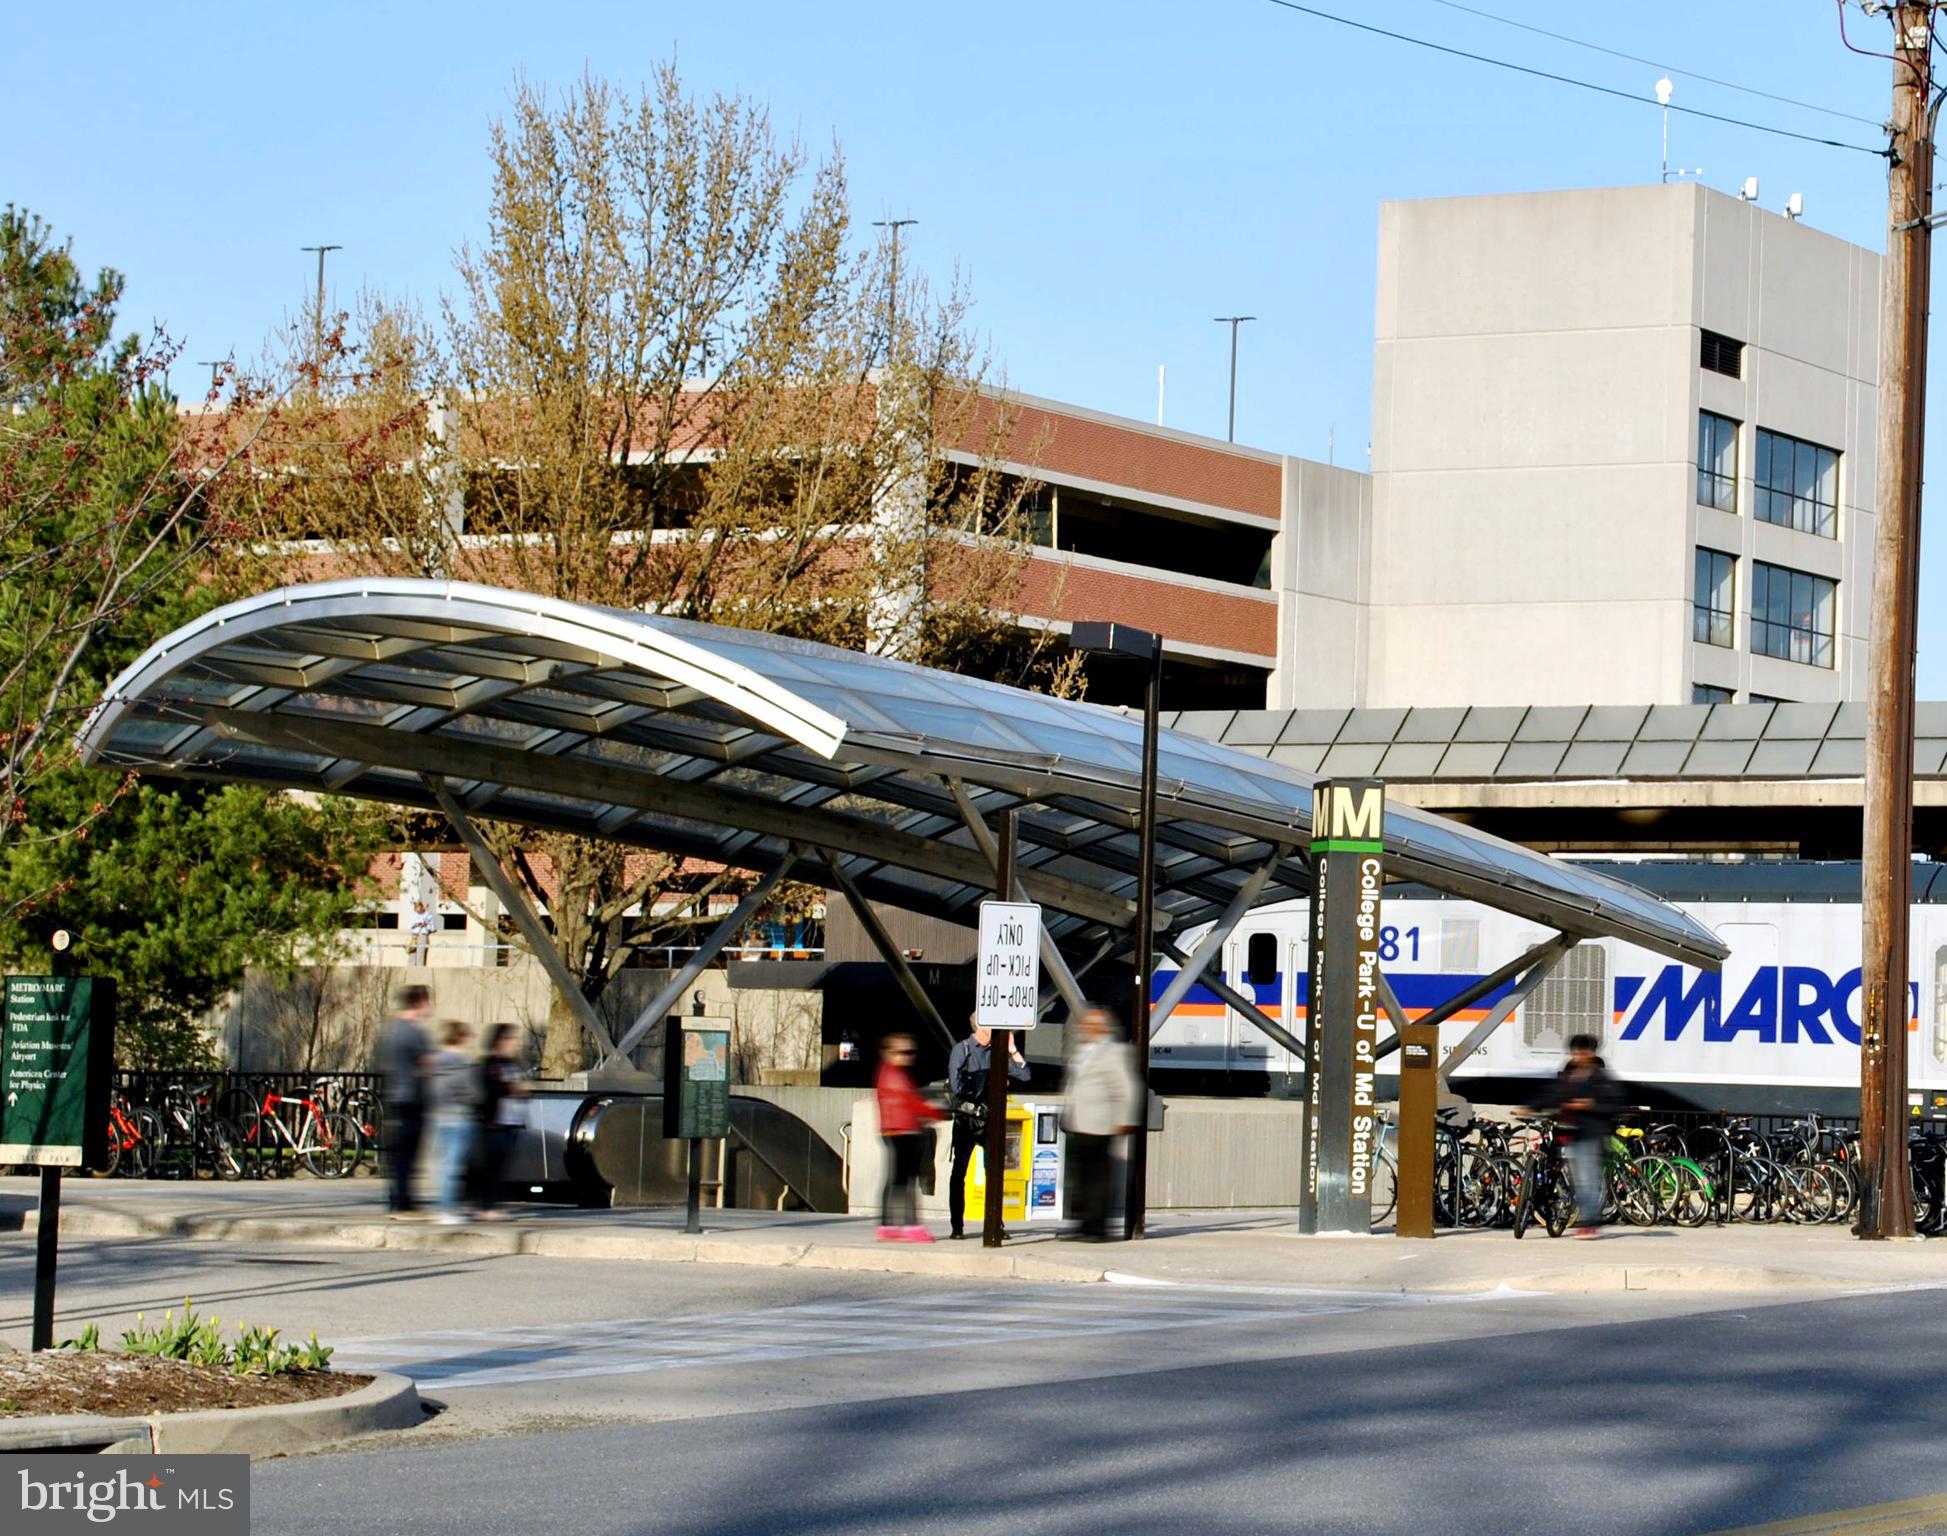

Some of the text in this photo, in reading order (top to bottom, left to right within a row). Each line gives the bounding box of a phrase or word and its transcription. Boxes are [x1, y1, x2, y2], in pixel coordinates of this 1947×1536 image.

[1312, 787, 1329, 839] M
[1332, 787, 1382, 839] M
[1316, 858, 1328, 941] College
[1356, 858, 1381, 942] College
[997, 924, 1023, 946] ONLY
[986, 953, 1031, 977] PICK-UP
[9, 993, 36, 1004] Station
[980, 984, 1035, 1008] DROP-OFF
[9, 1011, 45, 1022] Pedestrian
[12, 1023, 29, 1033] FDA
[11, 1040, 40, 1050] Aviation
[11, 1050, 37, 1063] Airport
[1313, 1040, 1320, 1063] of
[1355, 1039, 1374, 1063] of
[9, 1068, 43, 1079] American
[20, 1080, 46, 1092] Physics
[1312, 1072, 1320, 1105] Md
[1354, 1073, 1374, 1106] Md
[1309, 1116, 1319, 1193] Station
[1351, 1115, 1373, 1195] Station
